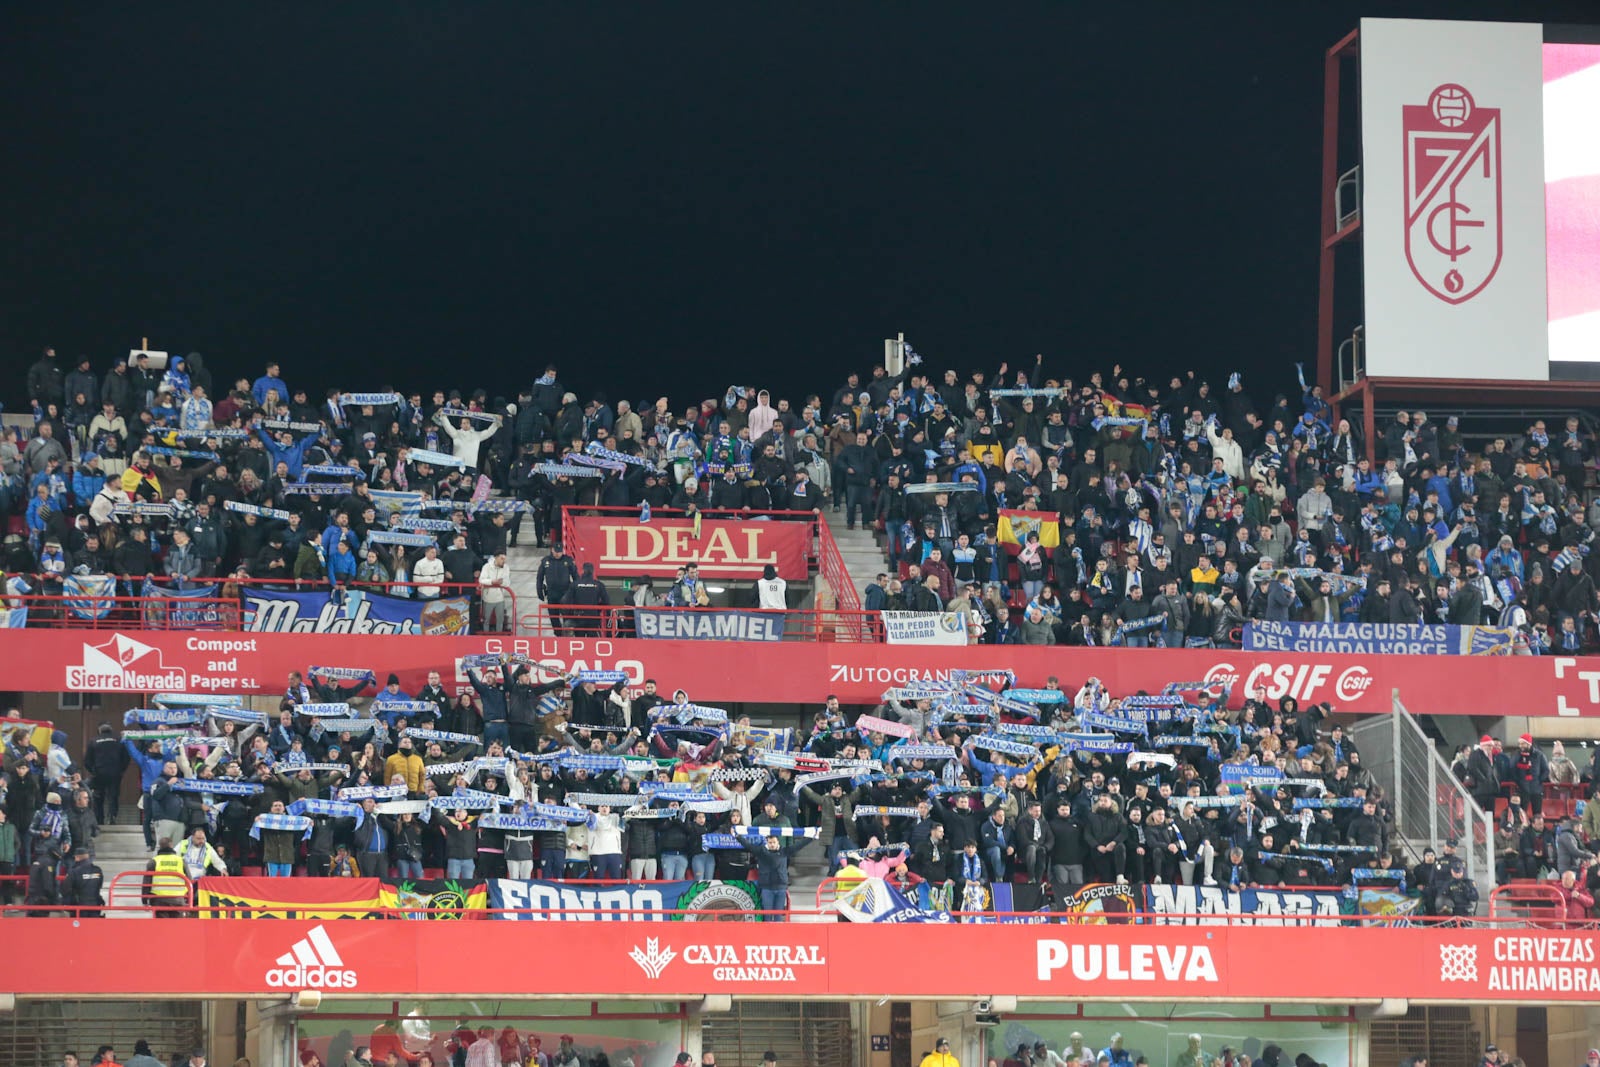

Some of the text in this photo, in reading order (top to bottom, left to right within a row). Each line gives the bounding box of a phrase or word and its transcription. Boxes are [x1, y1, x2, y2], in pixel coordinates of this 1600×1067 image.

[405, 518, 449, 529] MALAGA
[600, 525, 778, 564] IDEAL
[640, 613, 780, 641] BENAMIEL
[908, 620, 935, 630] PEDRO
[1251, 620, 1447, 641] PEÑA MALAGUISTAS
[186, 637, 257, 654] Compost
[485, 638, 613, 657] GRUPO
[1252, 631, 1291, 651] DEL
[207, 658, 237, 671] and
[71, 670, 185, 689] Sierra Nevada
[191, 675, 238, 691] Paper
[1244, 663, 1333, 701] CSIF
[1343, 675, 1373, 690] CSIF
[144, 710, 189, 722] MALAGA
[302, 704, 332, 713] MALAGA
[1002, 724, 1046, 734] MALAGA
[893, 748, 954, 757] MALAGA
[977, 737, 1031, 754] MALAGA
[1226, 766, 1275, 776] ZONA SOHO
[190, 781, 247, 794] MALAGA
[536, 805, 575, 818] MALAGA
[499, 817, 547, 828] MALAGA
[1064, 884, 1135, 907] EL PERCHEL
[1150, 884, 1343, 926] MALAGA
[683, 945, 826, 966] CAJA RURAL
[1494, 936, 1595, 963] CERVEZAS
[1036, 939, 1219, 982] PULEVA
[265, 964, 358, 988] adidas
[713, 968, 796, 981] GRANADA
[1488, 967, 1600, 992] ALHAMBRA
